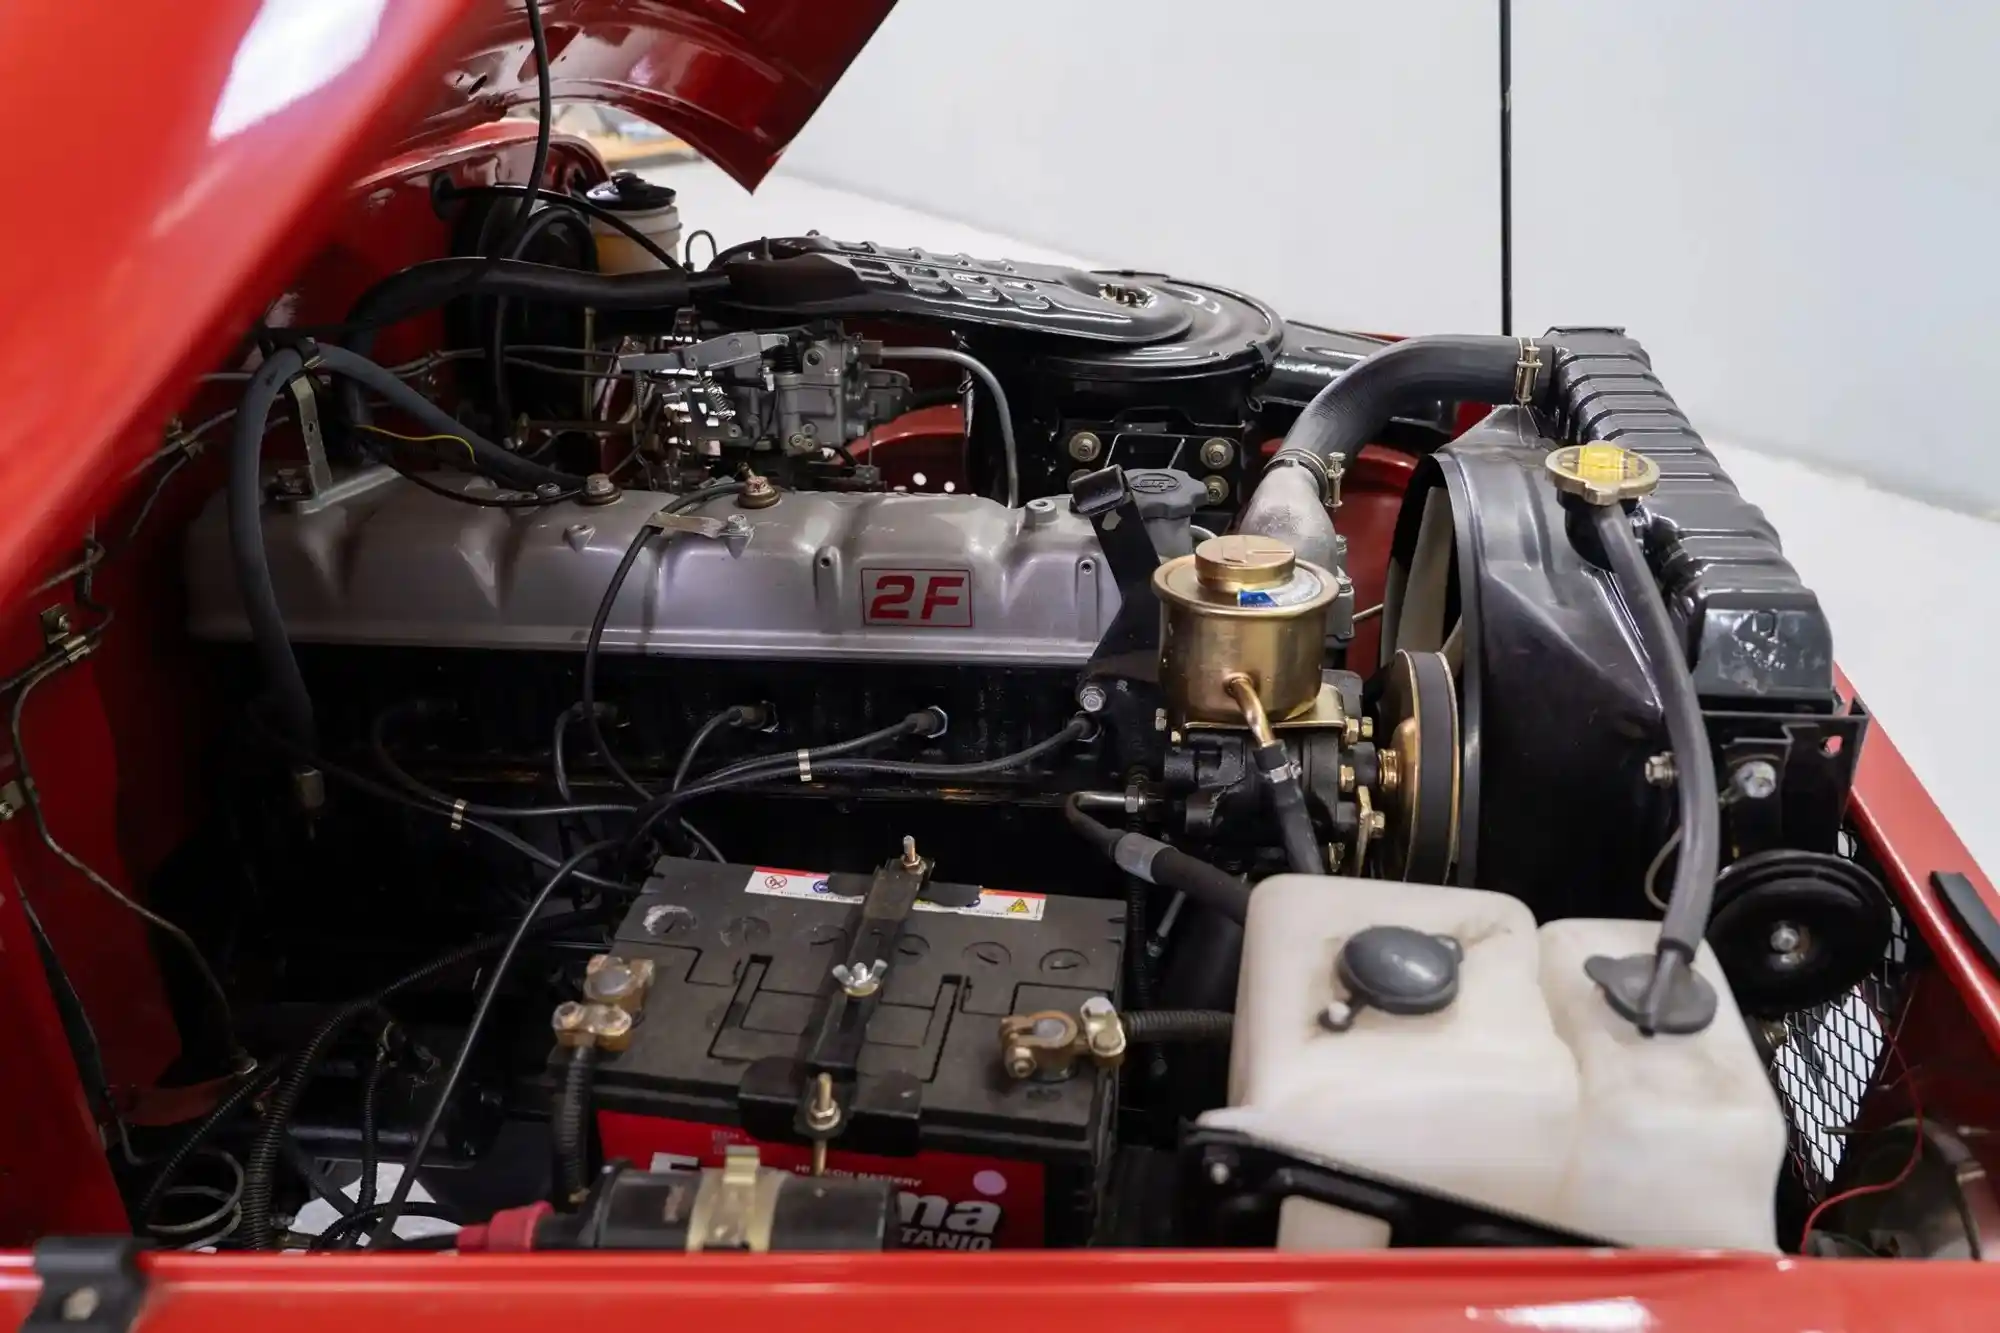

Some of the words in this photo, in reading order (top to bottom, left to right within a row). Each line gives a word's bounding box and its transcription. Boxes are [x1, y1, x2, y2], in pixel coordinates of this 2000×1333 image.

[869, 575, 965, 620] 2F
[898, 1191, 1002, 1234] na
[901, 1227, 992, 1252] TANIO
